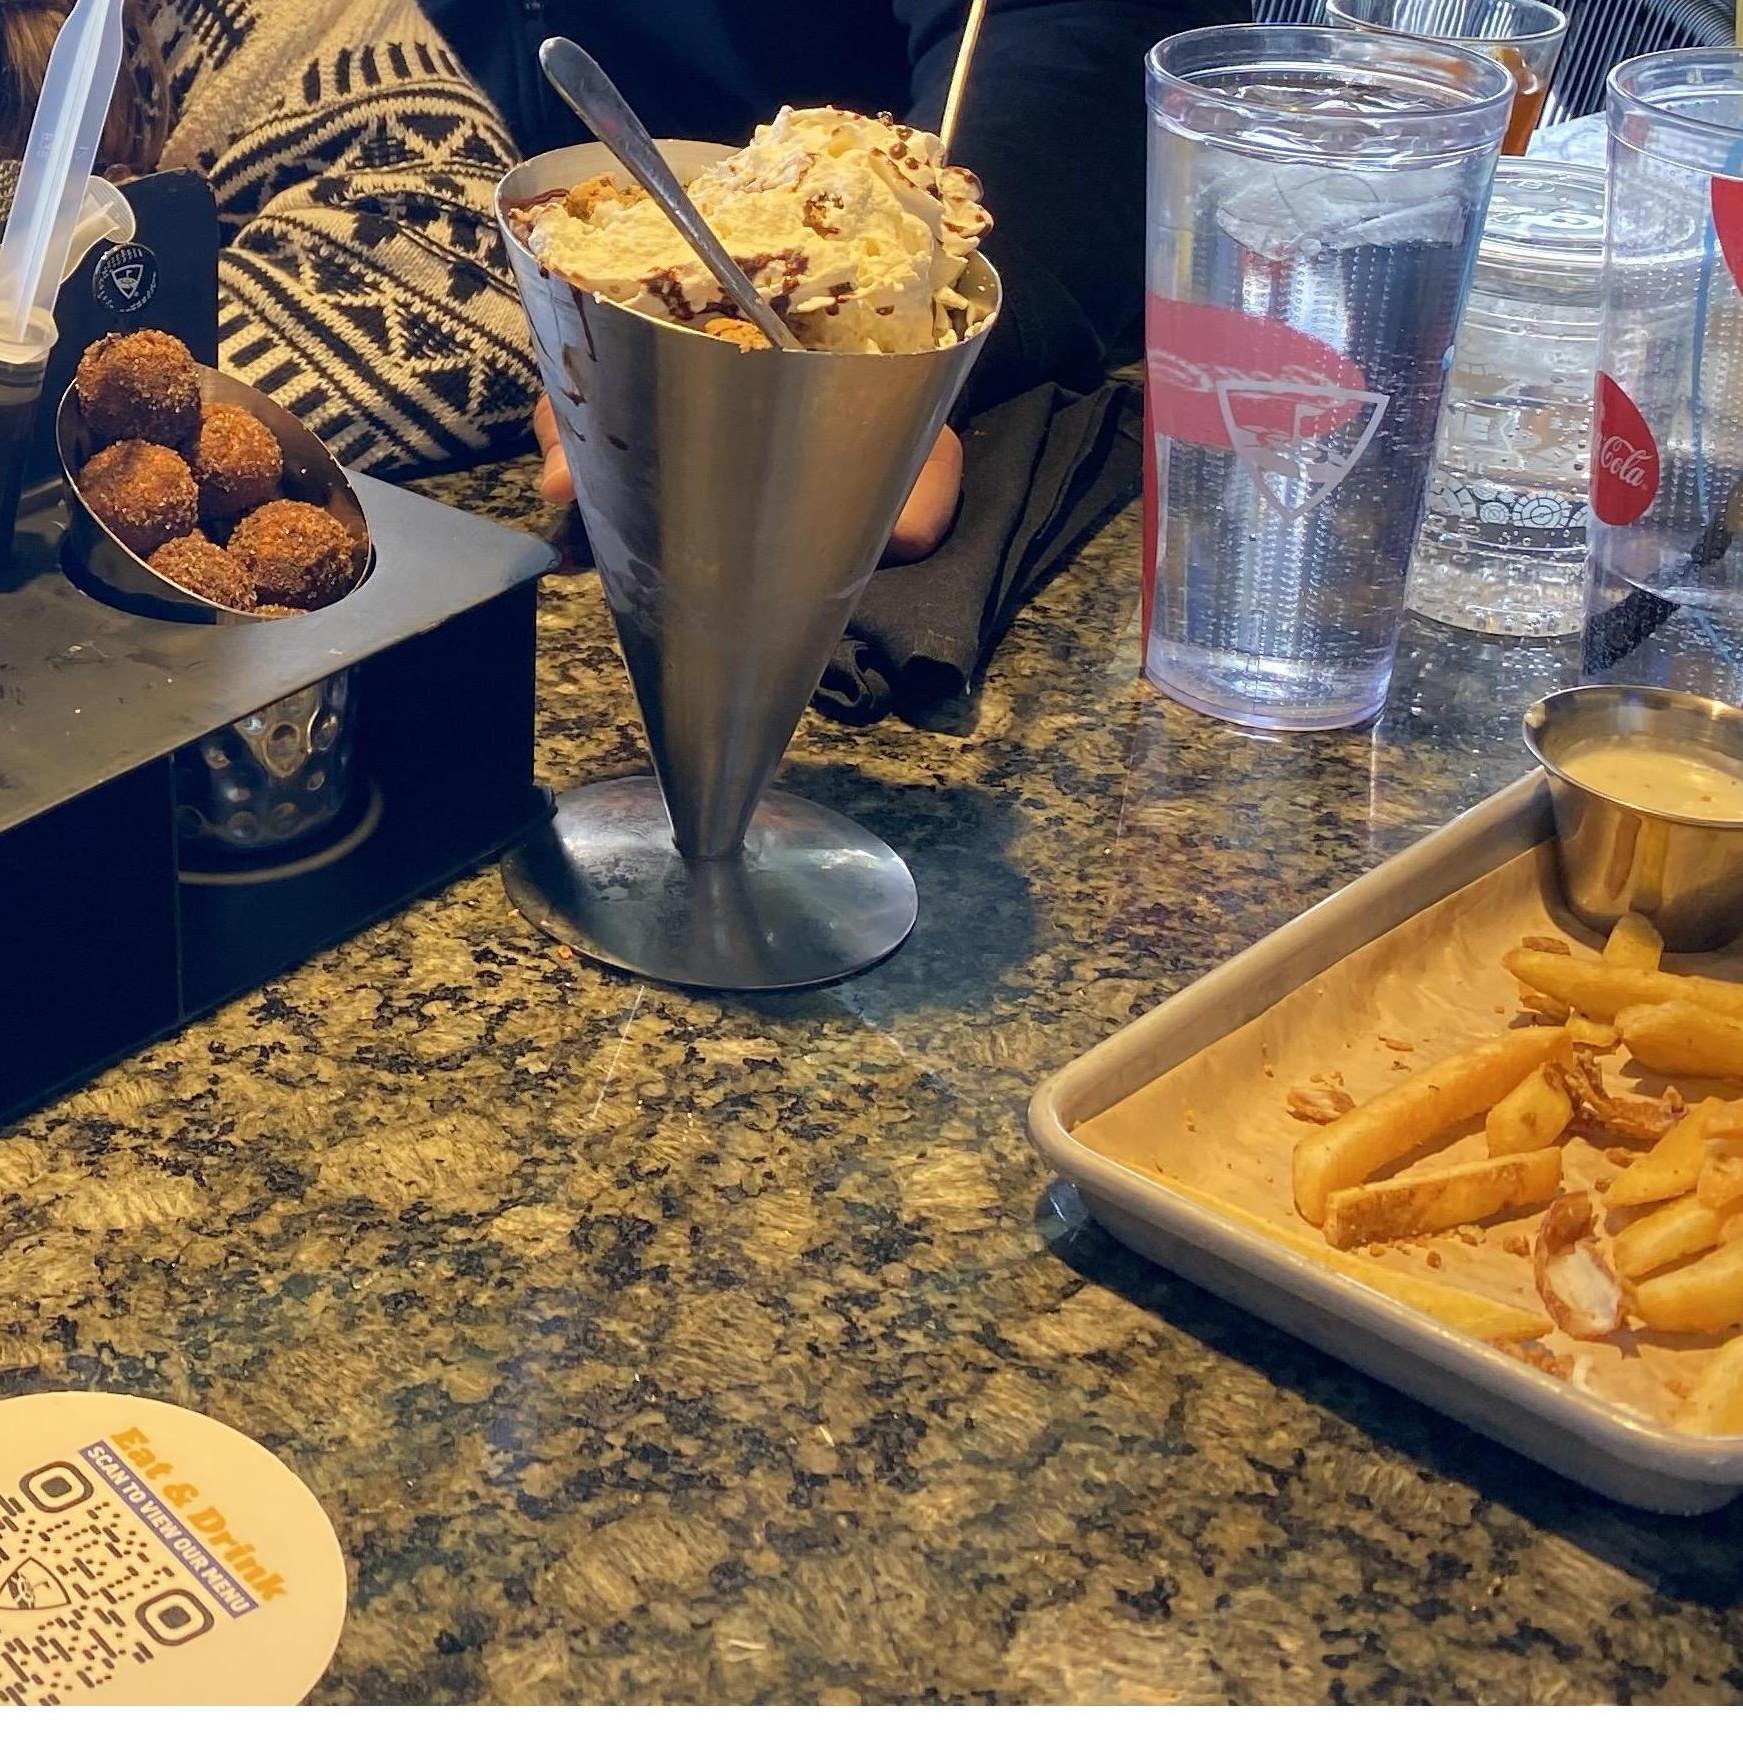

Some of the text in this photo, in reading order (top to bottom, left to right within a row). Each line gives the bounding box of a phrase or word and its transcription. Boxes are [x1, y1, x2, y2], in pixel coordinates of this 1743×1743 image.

[87, 1445, 251, 1613] SCAN TO VIEW OUR MENU
[110, 1426, 287, 1602] Eat & Drink
